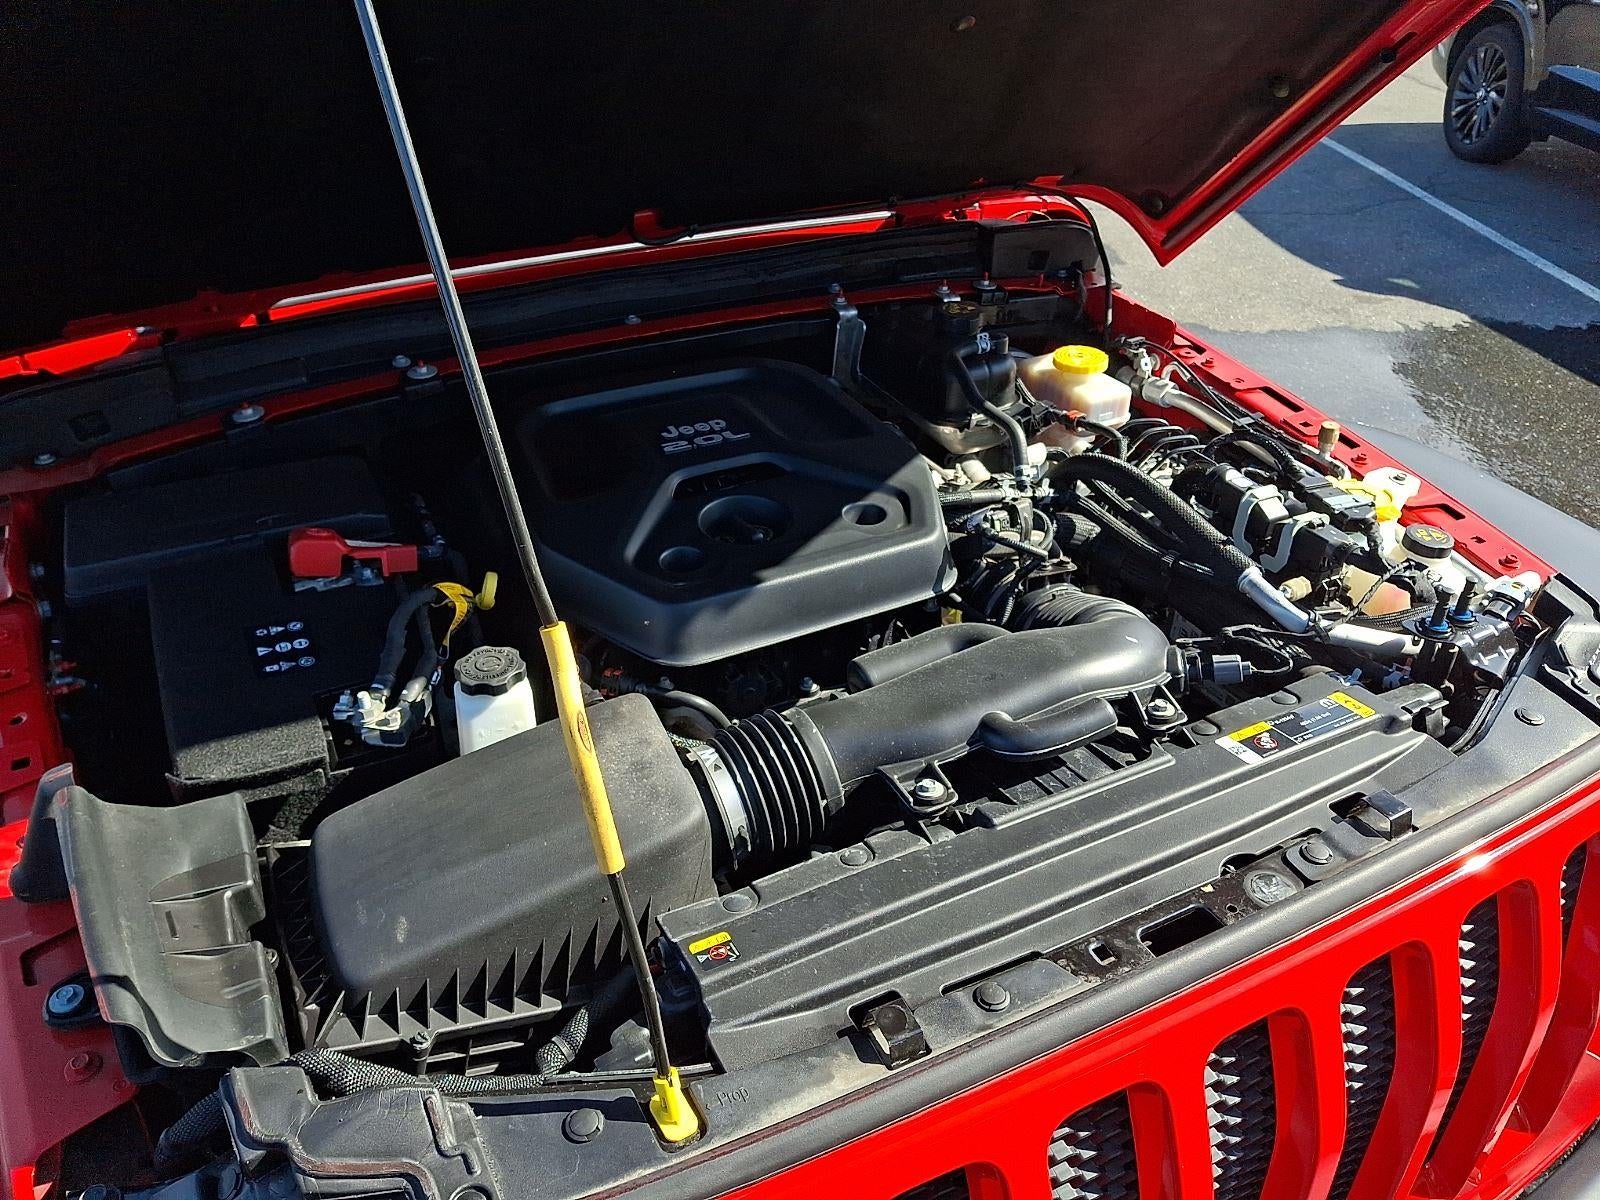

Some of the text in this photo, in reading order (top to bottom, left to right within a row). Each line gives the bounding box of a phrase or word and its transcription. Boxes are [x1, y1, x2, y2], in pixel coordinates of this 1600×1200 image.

[660, 419, 727, 438] Jeep
[660, 430, 752, 453] 2.0L
[715, 1087, 749, 1106] Prop
